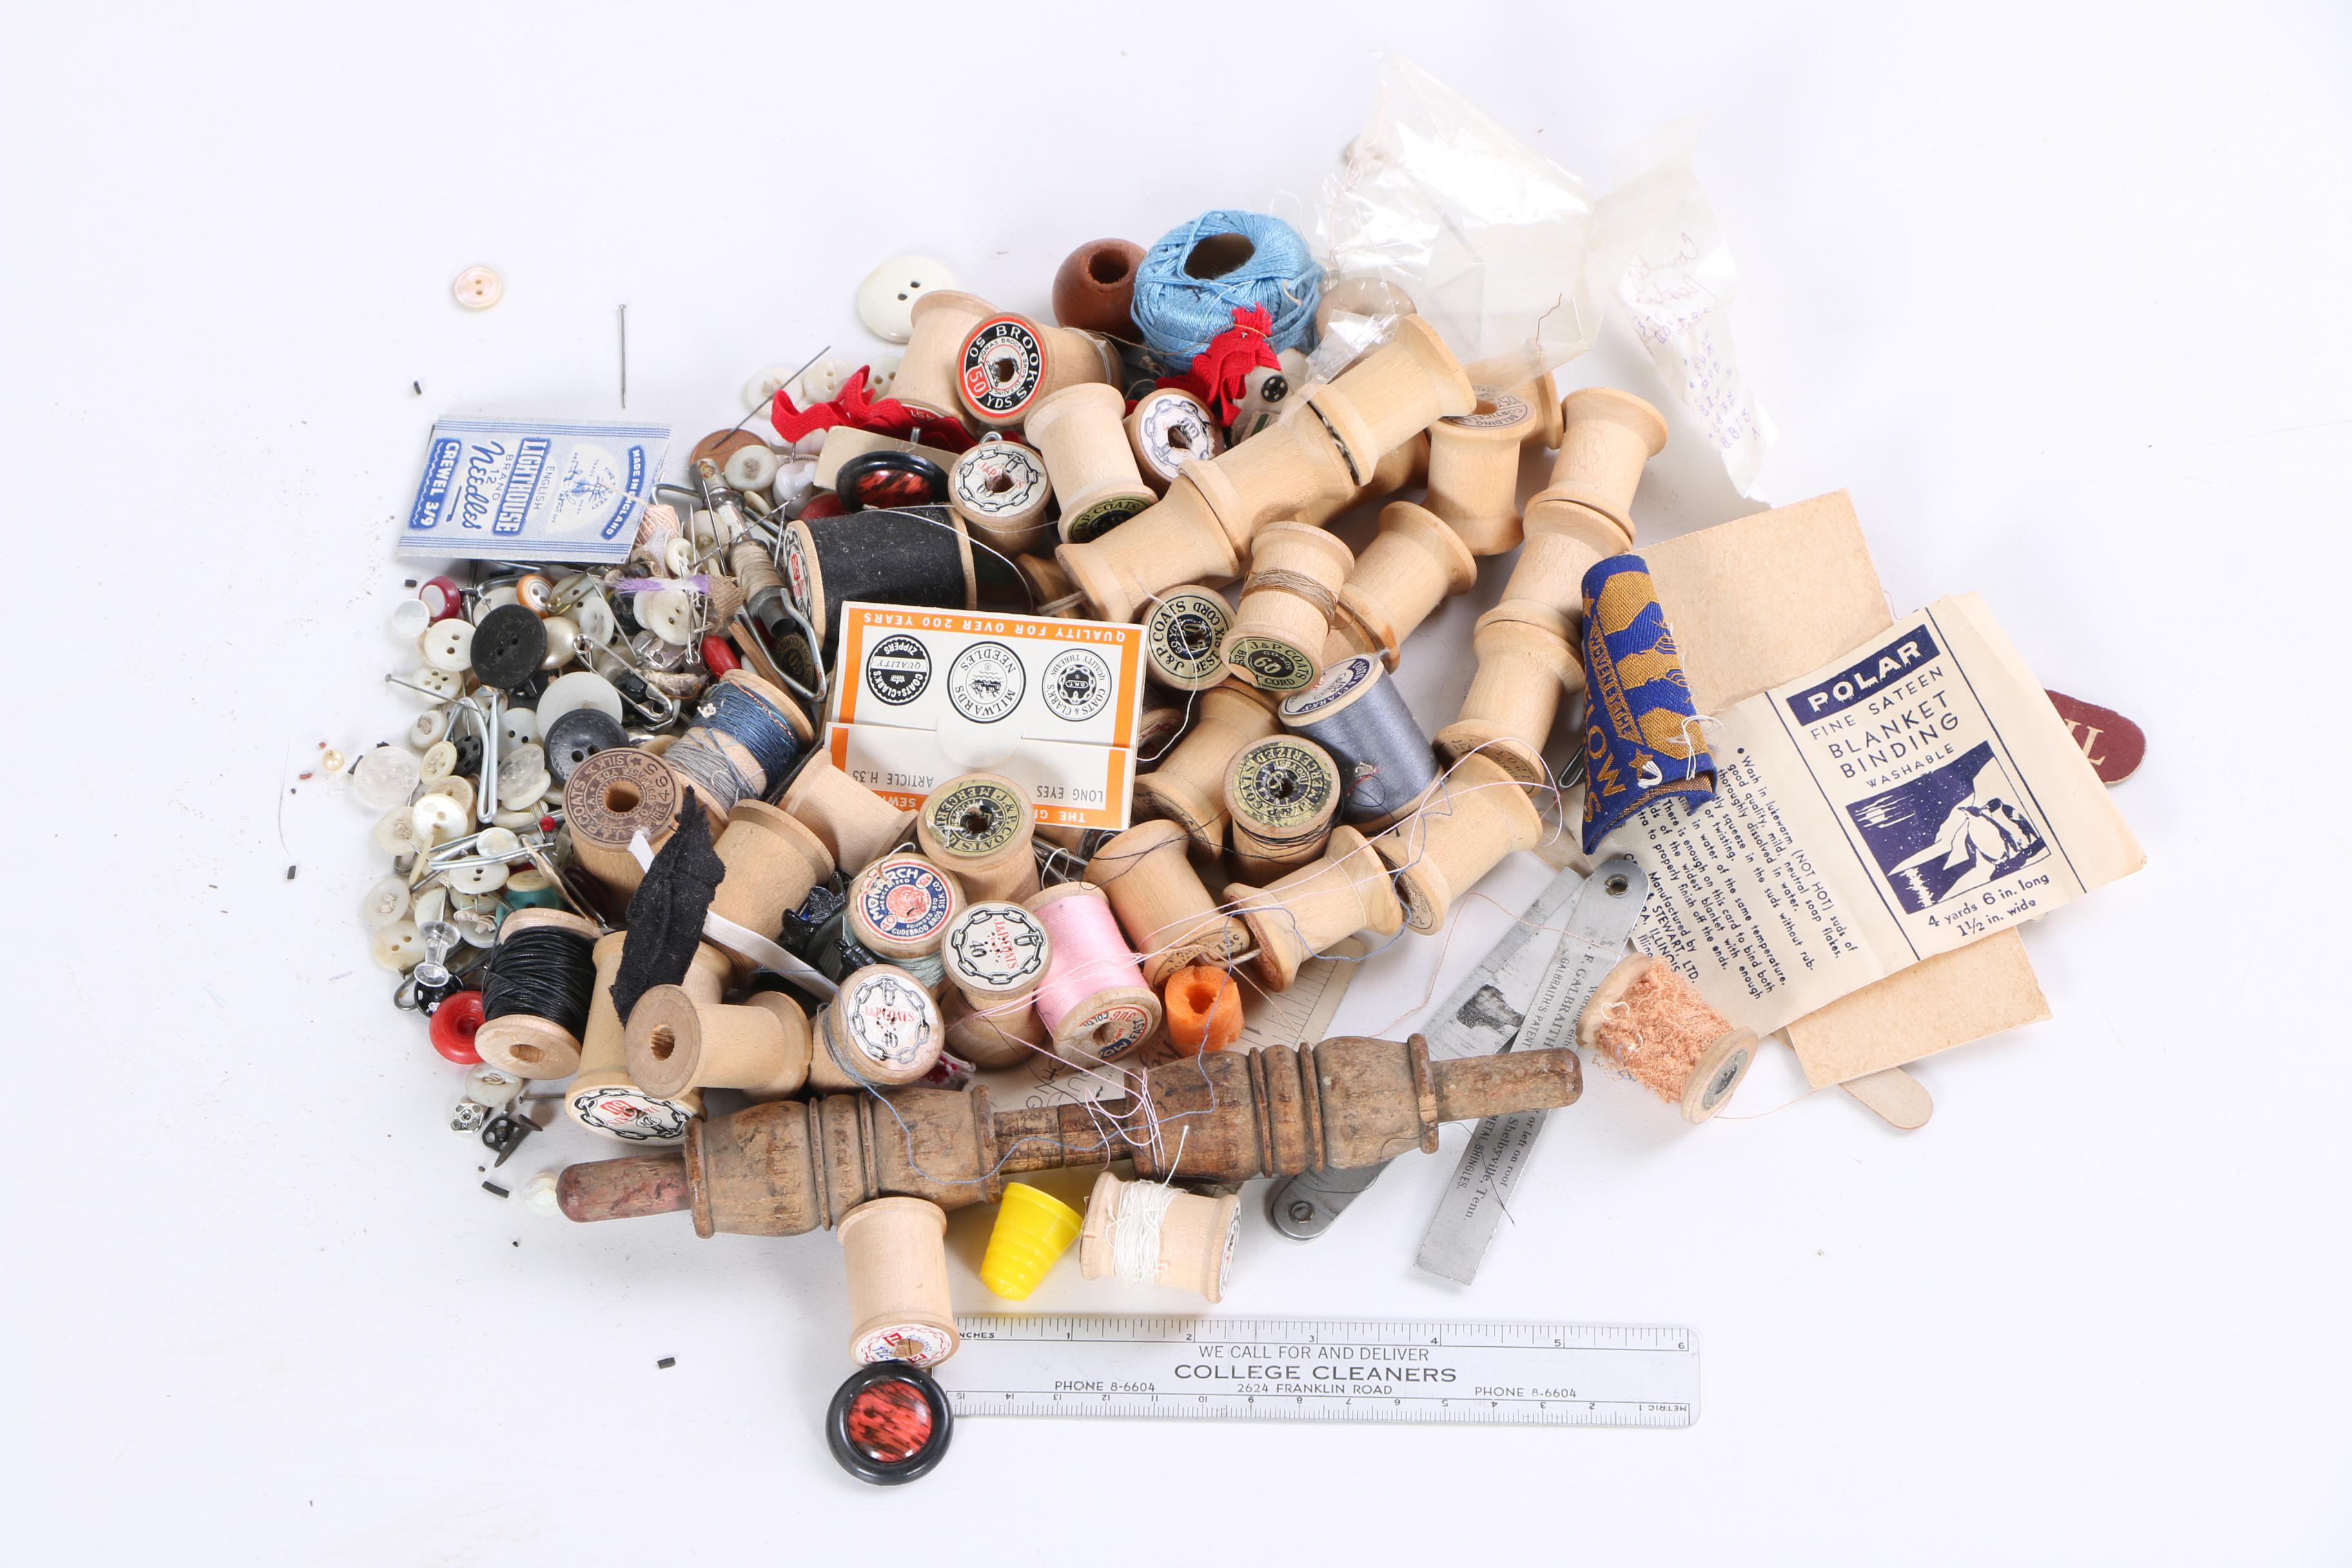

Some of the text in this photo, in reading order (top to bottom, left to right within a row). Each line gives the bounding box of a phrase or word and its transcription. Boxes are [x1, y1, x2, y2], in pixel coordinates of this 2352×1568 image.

[996, 326, 1038, 399] BROOK'S
[970, 371, 1012, 408] 50 YDS
[1476, 415, 1518, 426] BELDING
[429, 442, 459, 499] CREWEL
[486, 469, 500, 484] 12
[492, 454, 514, 500] BRAND
[631, 449, 641, 476] MADE
[495, 440, 548, 533] LIGHTHOUSE
[533, 466, 555, 510] ENGLISH
[1093, 502, 1141, 514] COATS
[863, 612, 1126, 642] QUALITY FOR OVER 200 YEARS
[1153, 601, 1186, 642] COATS
[884, 642, 917, 656] ZIPPERS
[1193, 602, 1219, 673] BEST CORD
[877, 660, 921, 669] QUALITY
[961, 649, 1016, 673] NEEDLES
[1050, 654, 1106, 681] QUALITY THREADS
[1254, 657, 1281, 673] 60
[1286, 650, 1309, 680] COATS
[1807, 640, 1922, 712] POLAR
[901, 674, 923, 697] COATS
[956, 685, 1015, 716] MILWARDS
[1082, 689, 1106, 715] COATS
[1810, 666, 1944, 740] FINE SATEEN
[1828, 691, 1952, 759] BLANKET
[596, 756, 624, 768] SILK
[1839, 716, 1959, 779] BINDING
[887, 773, 934, 788] ARTICLE
[1257, 748, 1324, 799] MERCERIZED
[1865, 743, 1955, 789] WASHABLE
[571, 779, 591, 825] COATS
[1037, 785, 1103, 802] LONG EYES
[1242, 765, 1262, 809] COATS
[1059, 811, 1086, 823] THE
[1705, 808, 1713, 819] or
[1718, 769, 1781, 877] thoroughly dissolved in
[962, 827, 1012, 850] COATS
[1729, 764, 1821, 923] good neutral soap
[1742, 755, 1858, 952] Wash in lukewarm (NOT HOT) suds of
[1692, 819, 1752, 921] in water of the same
[1723, 814, 1801, 947] squeeze in the suds without
[933, 881, 942, 891] CO
[1648, 829, 1656, 839] to
[1653, 844, 1678, 881] properly
[1679, 883, 1694, 908] finish
[1693, 911, 1705, 925] off
[1701, 926, 1714, 943] the
[1662, 799, 1679, 827] There
[1678, 828, 1685, 836] is
[1683, 839, 1707, 874] enough
[1704, 876, 1713, 888] on
[1712, 889, 1724, 906] this
[1722, 908, 1741, 930] card
[1736, 932, 1745, 943] to
[1744, 946, 1758, 968] bind
[1758, 970, 1773, 994] both
[1928, 874, 2050, 927] 4 yards 6 in. long
[882, 916, 896, 930] 40
[906, 913, 933, 928] FOUNDED
[929, 910, 943, 926] BROS
[1649, 871, 1696, 953] Manufactured by
[1660, 825, 1763, 1001] of the widest blanket with enough
[1987, 899, 2036, 925] in. wide
[892, 925, 929, 936] GUDEBROD
[1652, 905, 1699, 983] STEWART, LTD.
[970, 940, 986, 957] 40
[1522, 957, 1570, 1048] GALBRAITH'S PATENT
[1543, 954, 1594, 1048] F. GALBRAITH
[882, 1032, 898, 1048] 40
[1456, 1115, 1499, 1189] METAL SHINGLES.
[1500, 1117, 1535, 1188] or left on roof
[1464, 1117, 1518, 1220] Shelbyville, Tenn.
[1199, 1346, 1429, 1361] WE CALL FOR AND DELIVER
[1055, 1380, 1155, 1392] PHONE 8-6604
[1174, 1364, 1457, 1383] COLLEGE CLEANERS
[1237, 1384, 1393, 1395] 2624 FRANKLIN ROAD
[1475, 1387, 1577, 1398] PHONE 8-6604
